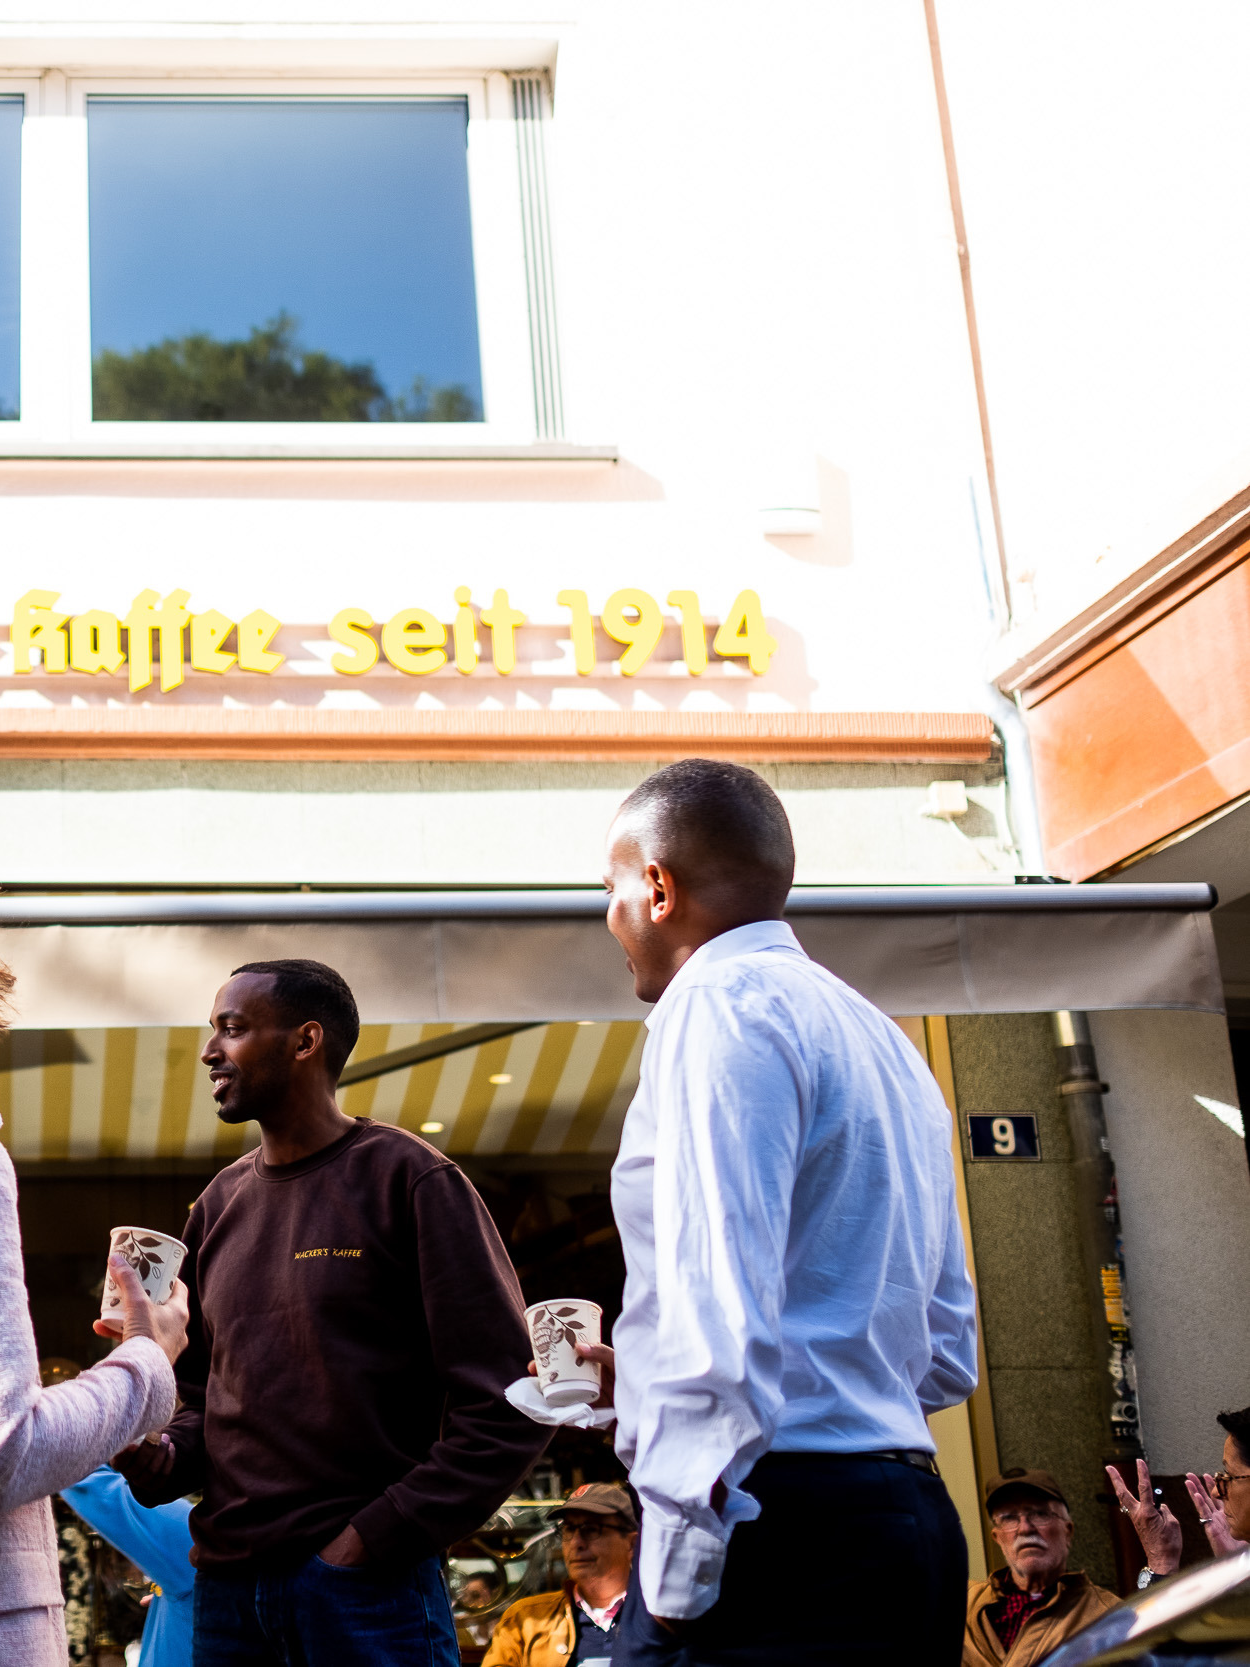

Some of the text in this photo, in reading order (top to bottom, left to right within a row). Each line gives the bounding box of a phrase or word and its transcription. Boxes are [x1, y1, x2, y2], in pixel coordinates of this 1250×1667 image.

[10, 588, 286, 693] Kaffee
[328, 586, 527, 675] seit
[557, 588, 778, 676] 1914
[992, 1117, 1016, 1155] 9
[294, 1247, 362, 1260] WACKER'S KAFFEE
